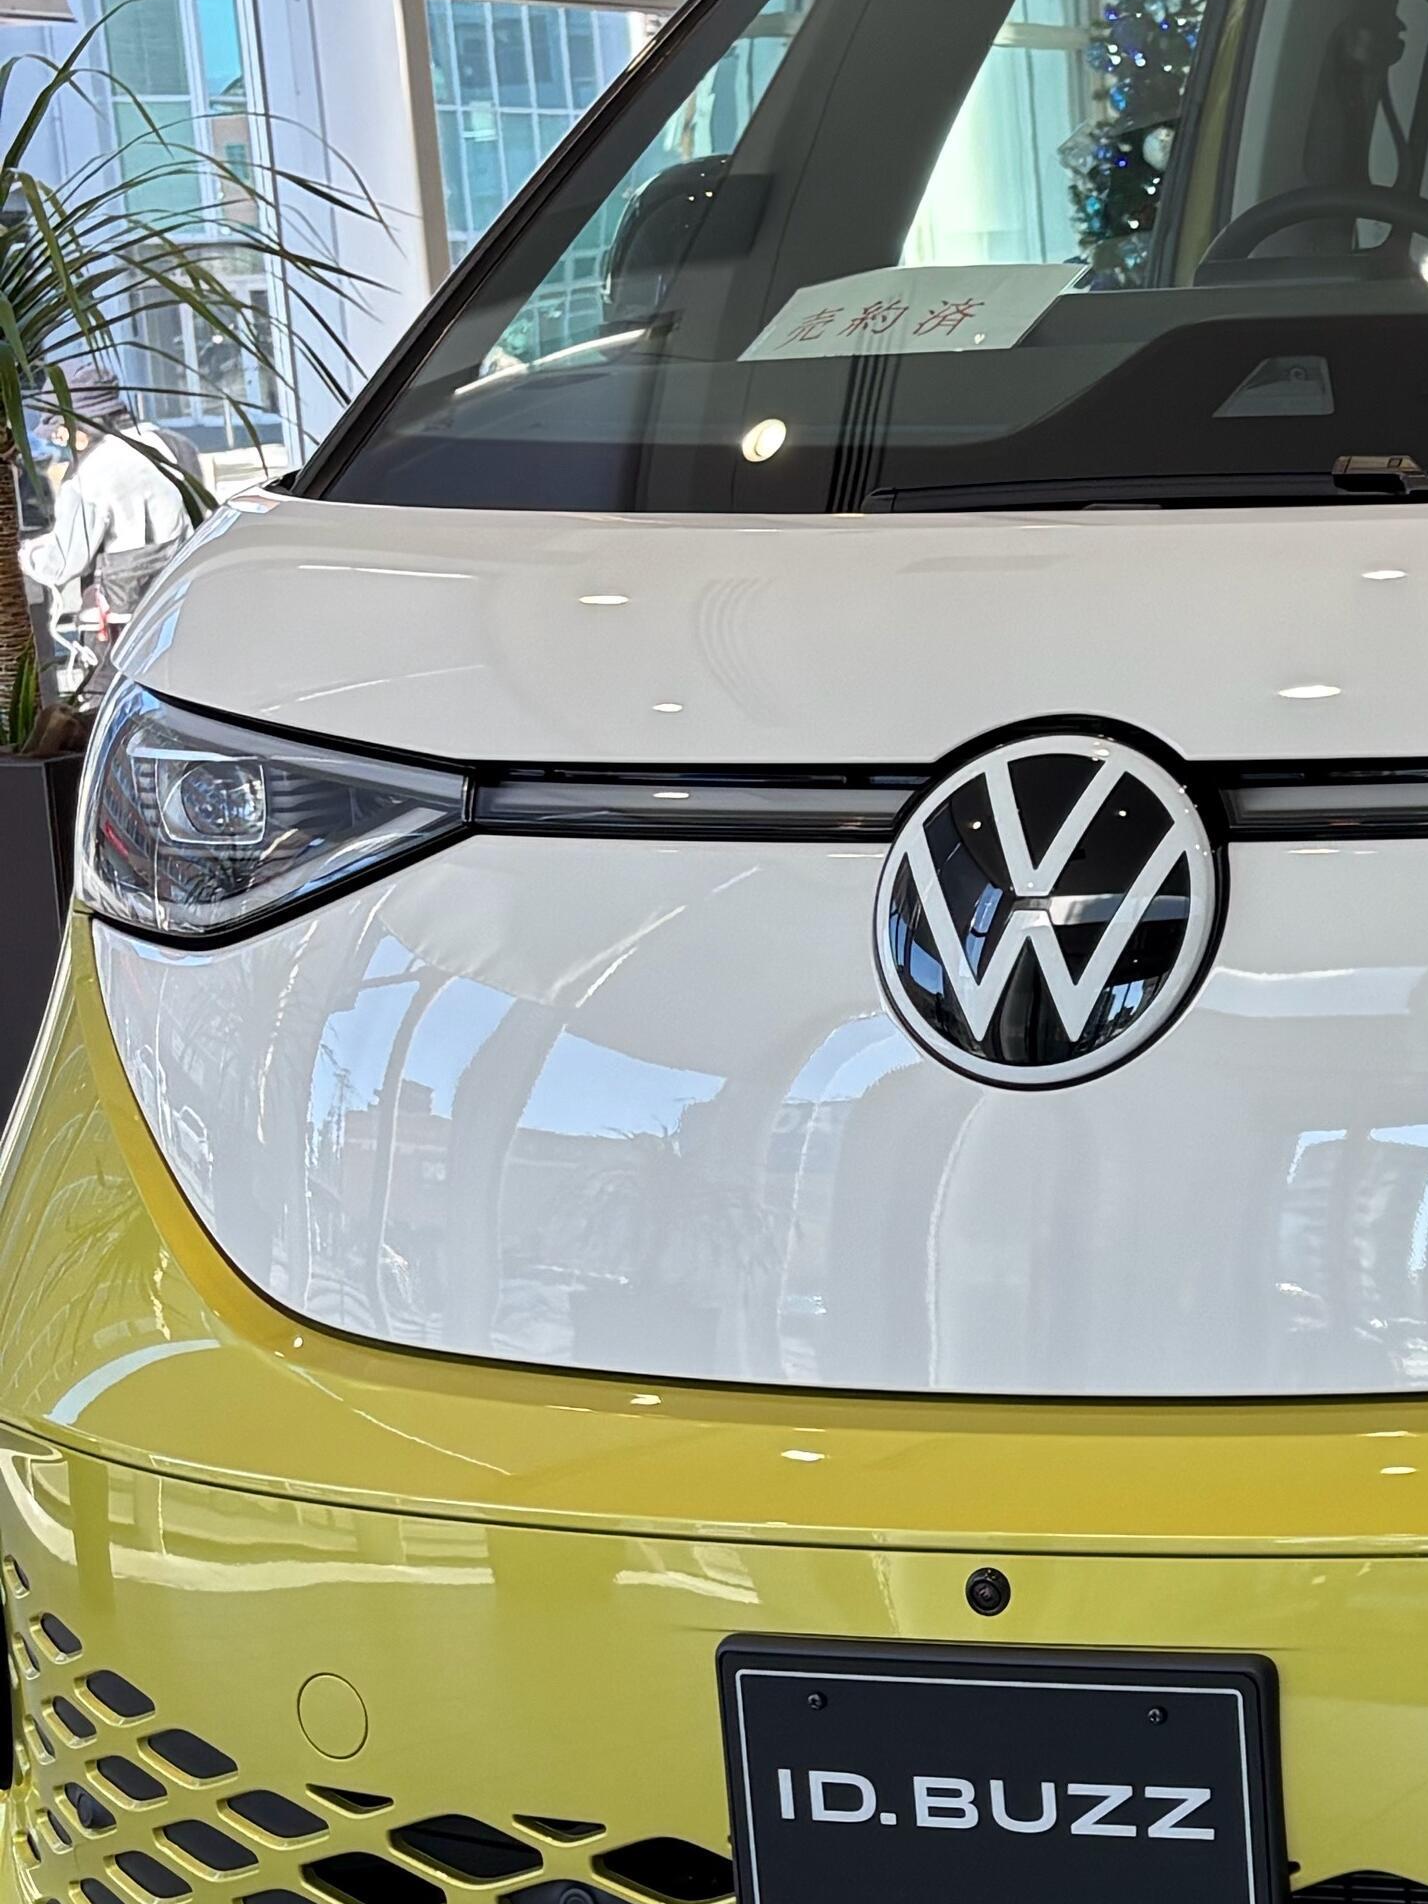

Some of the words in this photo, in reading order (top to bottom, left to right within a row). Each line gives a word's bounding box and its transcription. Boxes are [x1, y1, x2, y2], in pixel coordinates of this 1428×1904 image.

[774, 298, 985, 351] 売約済
[776, 1768, 1216, 1841] ID.BUZZ
